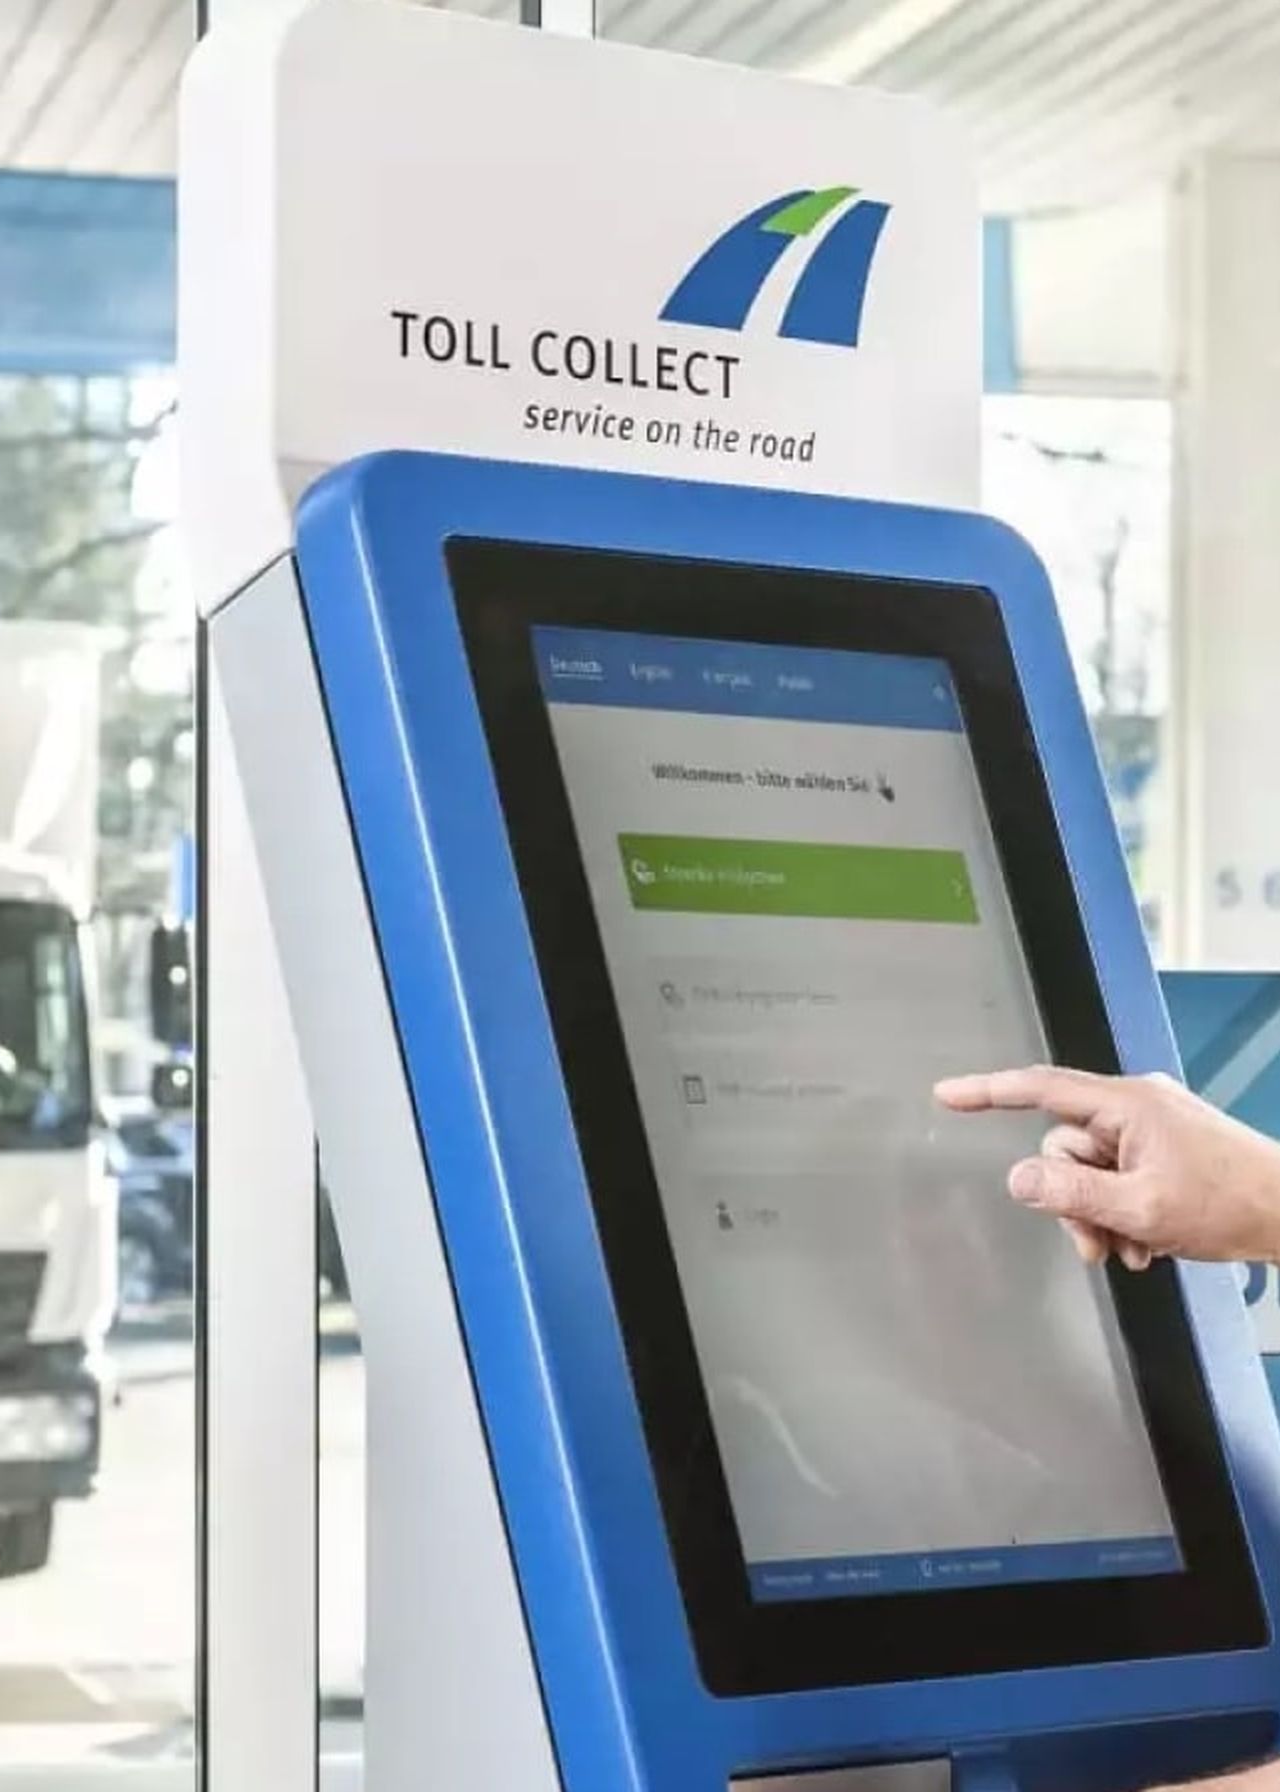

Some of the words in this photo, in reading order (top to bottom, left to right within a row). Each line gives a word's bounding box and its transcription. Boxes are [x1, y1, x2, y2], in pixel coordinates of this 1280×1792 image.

[391, 310, 511, 371] TOLL
[531, 330, 740, 399] COLLECT
[523, 402, 634, 442] service
[646, 418, 681, 446] on
[693, 419, 739, 454] the
[749, 431, 816, 463] road
[651, 762, 744, 787] Willkommen
